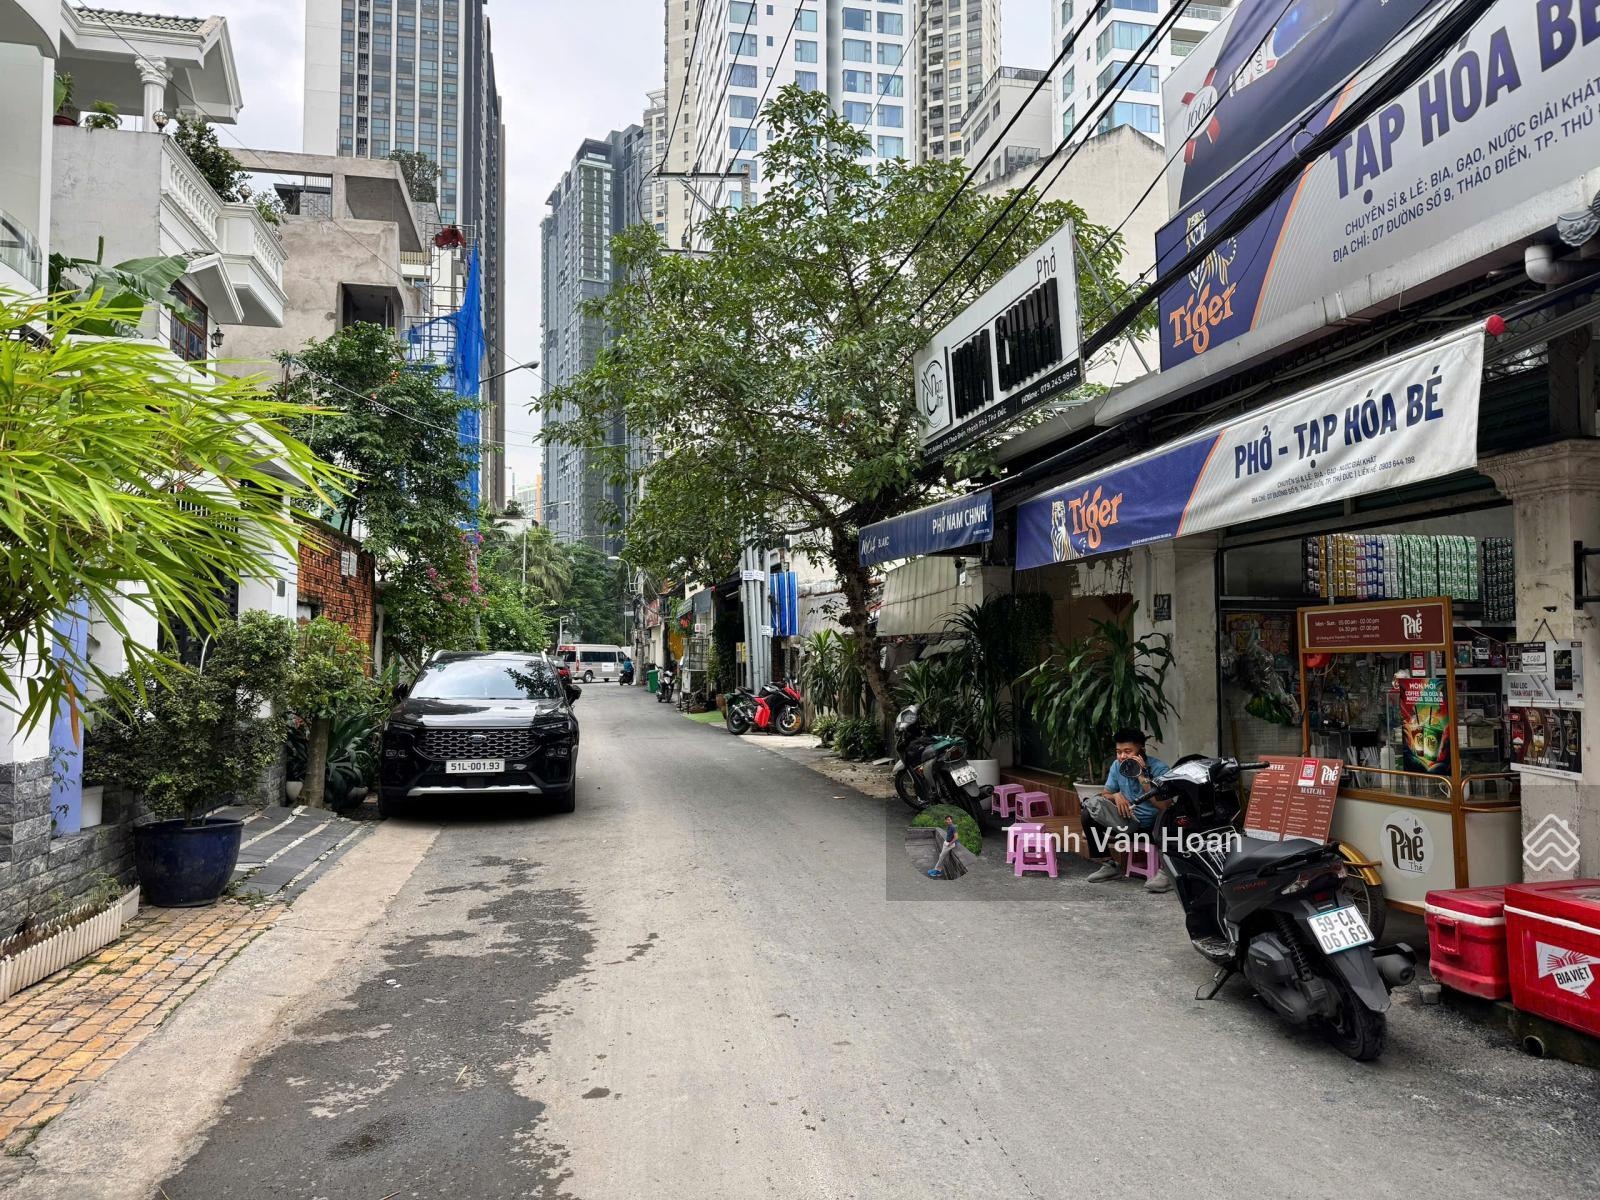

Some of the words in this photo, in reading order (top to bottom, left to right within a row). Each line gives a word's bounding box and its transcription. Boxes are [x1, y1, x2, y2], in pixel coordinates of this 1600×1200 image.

[1329, 103, 1405, 204] TẠP
[1418, 25, 1522, 147] HÓA
[1333, 245, 1349, 263] ĐỊA
[1372, 224, 1384, 242] 07
[1386, 203, 1424, 235] ĐƯỜNG
[1426, 191, 1441, 212] SỐ
[1444, 188, 1454, 203] 9,
[1457, 165, 1491, 195] THẢO
[1495, 146, 1531, 174] ĐIỀN,
[1534, 131, 1557, 151] TP.
[1561, 104, 1593, 138] THỦ
[1345, 201, 1386, 236] CHUYÊN
[1399, 191, 1408, 205] &
[1430, 165, 1454, 189] BIA,
[1457, 147, 1486, 174] GẠO,
[1488, 121, 1526, 156] NƯỚC
[1529, 101, 1558, 131] GIẢI
[1036, 246, 1057, 281] Phở
[1169, 280, 1237, 354] Tiger
[1234, 425, 1273, 479] PHỞ
[1293, 413, 1338, 469] TẠP
[1344, 389, 1398, 446] HÓA
[1406, 365, 1444, 427] BÉ
[946, 511, 964, 531] NAM
[1069, 485, 1123, 549] Tiger
[450, 761, 500, 772] 51L-001.93
[1301, 787, 1326, 796] MATCHA
[1315, 909, 1357, 933] 59-CA
[1321, 924, 1369, 950] 061.69
[1555, 971, 1572, 985] BIA
[1571, 966, 1590, 982] VIỆT
